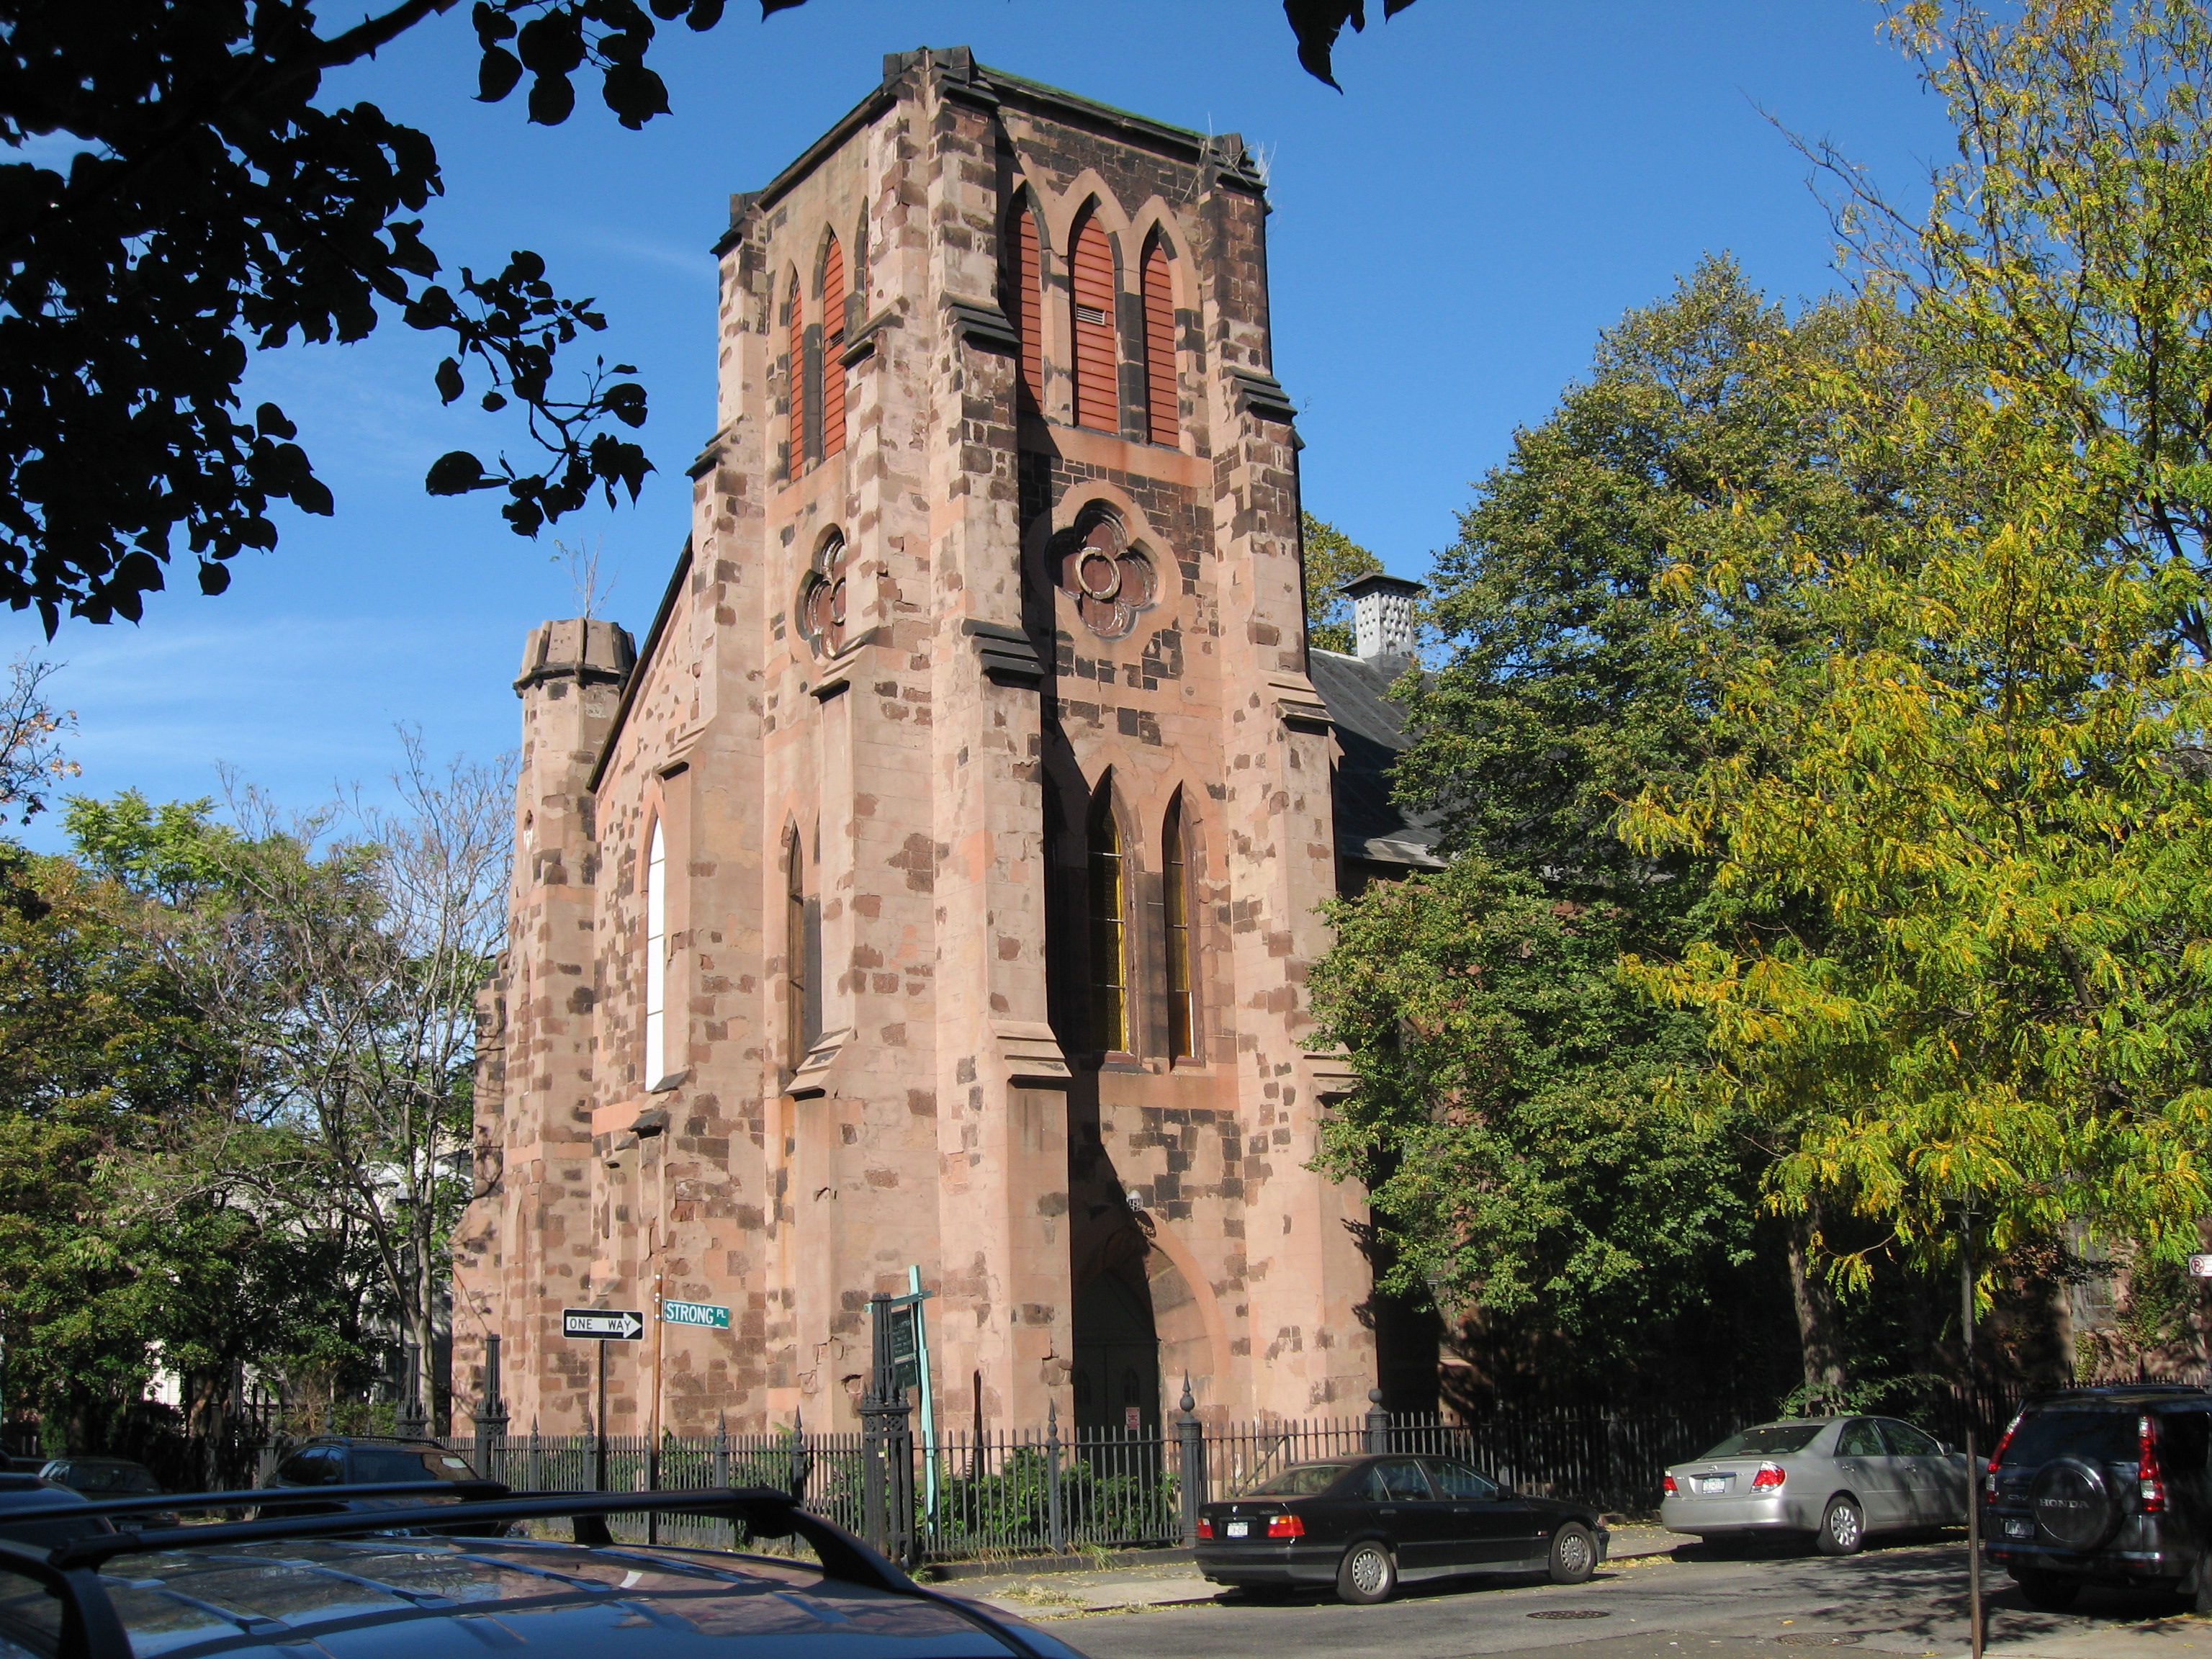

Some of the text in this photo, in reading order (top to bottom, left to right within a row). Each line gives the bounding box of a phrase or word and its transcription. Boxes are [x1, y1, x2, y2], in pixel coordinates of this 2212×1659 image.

[666, 1303, 726, 1324] STRONG PL
[570, 1318, 631, 1331] ONE WAY
[2039, 1498, 2090, 1509] HONDA
